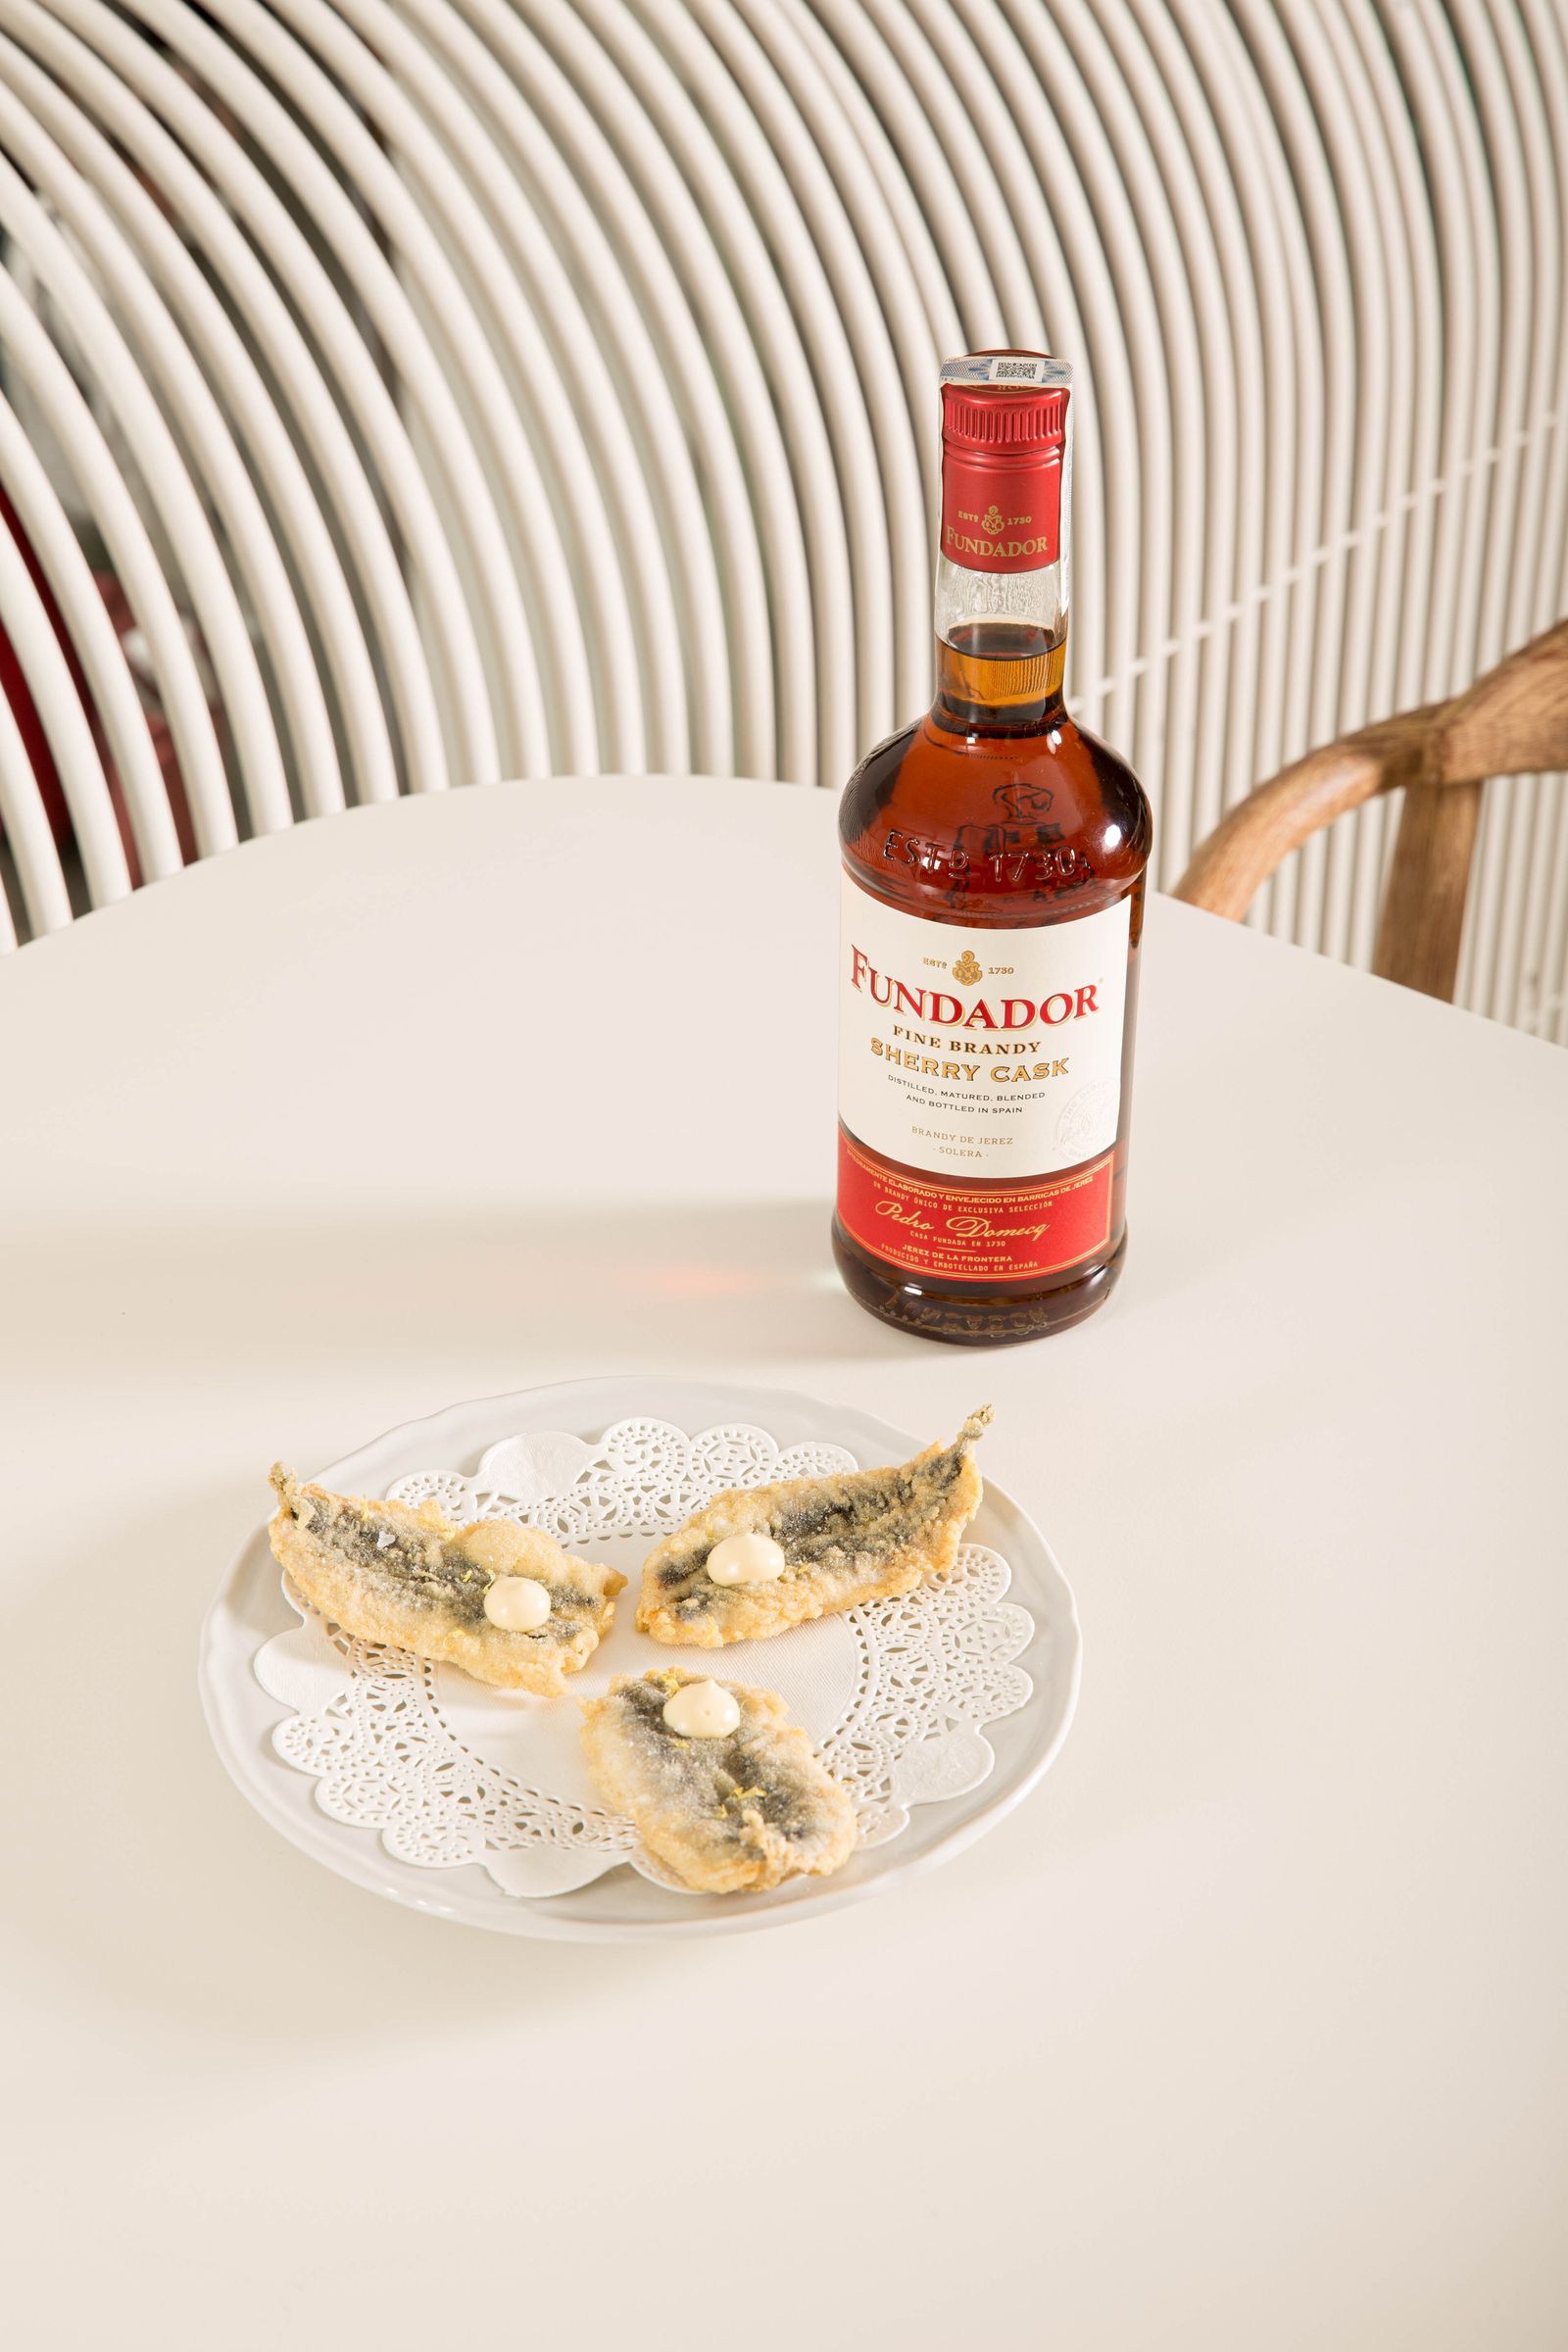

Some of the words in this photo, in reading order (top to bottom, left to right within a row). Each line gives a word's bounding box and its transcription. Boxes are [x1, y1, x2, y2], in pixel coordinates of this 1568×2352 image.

[1007, 515, 1032, 525] 1730
[946, 524, 1048, 557] FUNDADOR
[989, 846, 1076, 883] 1730
[988, 966, 1014, 975] 1730
[851, 944, 1101, 1033] FUNDADOR
[893, 1024, 942, 1049] FINE
[949, 1041, 1042, 1055] BRANDY
[870, 1037, 981, 1082] SHERRY
[990, 1057, 1070, 1083] CASK
[888, 1074, 938, 1096] DISTILLED,
[941, 1090, 993, 1102] MATURED,
[997, 1091, 1046, 1102] BLENDED
[906, 1094, 926, 1104] AND
[928, 1100, 975, 1113] BOTTLED
[911, 1126, 956, 1143] BRANDY
[959, 1135, 975, 1145] DE
[977, 1137, 1013, 1146] JEREZ
[939, 1146, 983, 1158] SOLERA
[888, 1178, 937, 1199] ELABORADO
[946, 1195, 1002, 1203] ENVEJECIDO
[1017, 1189, 1059, 1202] BARRICAS
[1060, 1185, 1072, 1194] DE
[957, 1205, 1004, 1214] EXCLUSIVA
[875, 1200, 935, 1230] Pedro
[946, 1215, 1051, 1242] Domecq
[909, 1230, 929, 1240] CASA
[933, 1236, 966, 1246] FUNDADA
[903, 1244, 930, 1257] JEREZ
[933, 1260, 989, 1272] EMBOTELLADO
